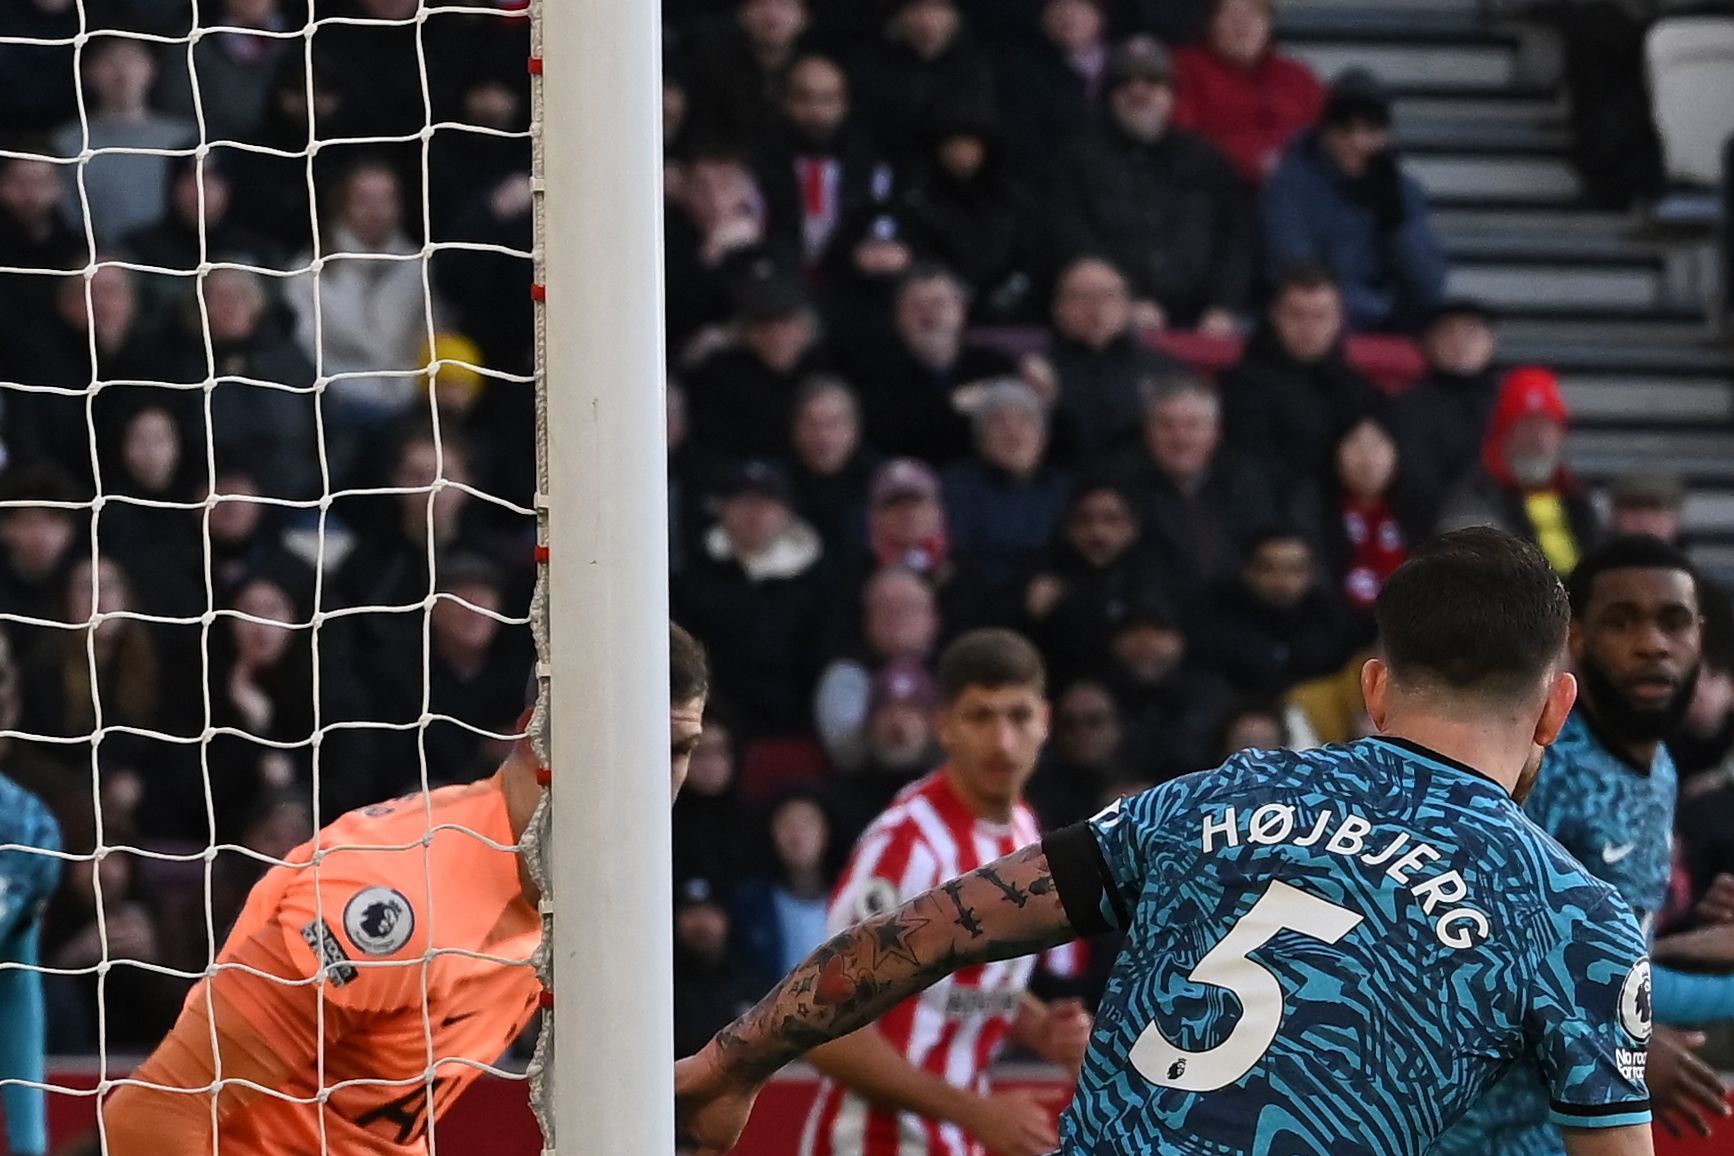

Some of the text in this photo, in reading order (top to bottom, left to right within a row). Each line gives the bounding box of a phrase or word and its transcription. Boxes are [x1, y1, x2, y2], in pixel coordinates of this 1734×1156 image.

[1202, 802, 1490, 949] HØJBJERG
[1128, 879, 1365, 1093] 5
[1615, 1049, 1632, 1066] No
